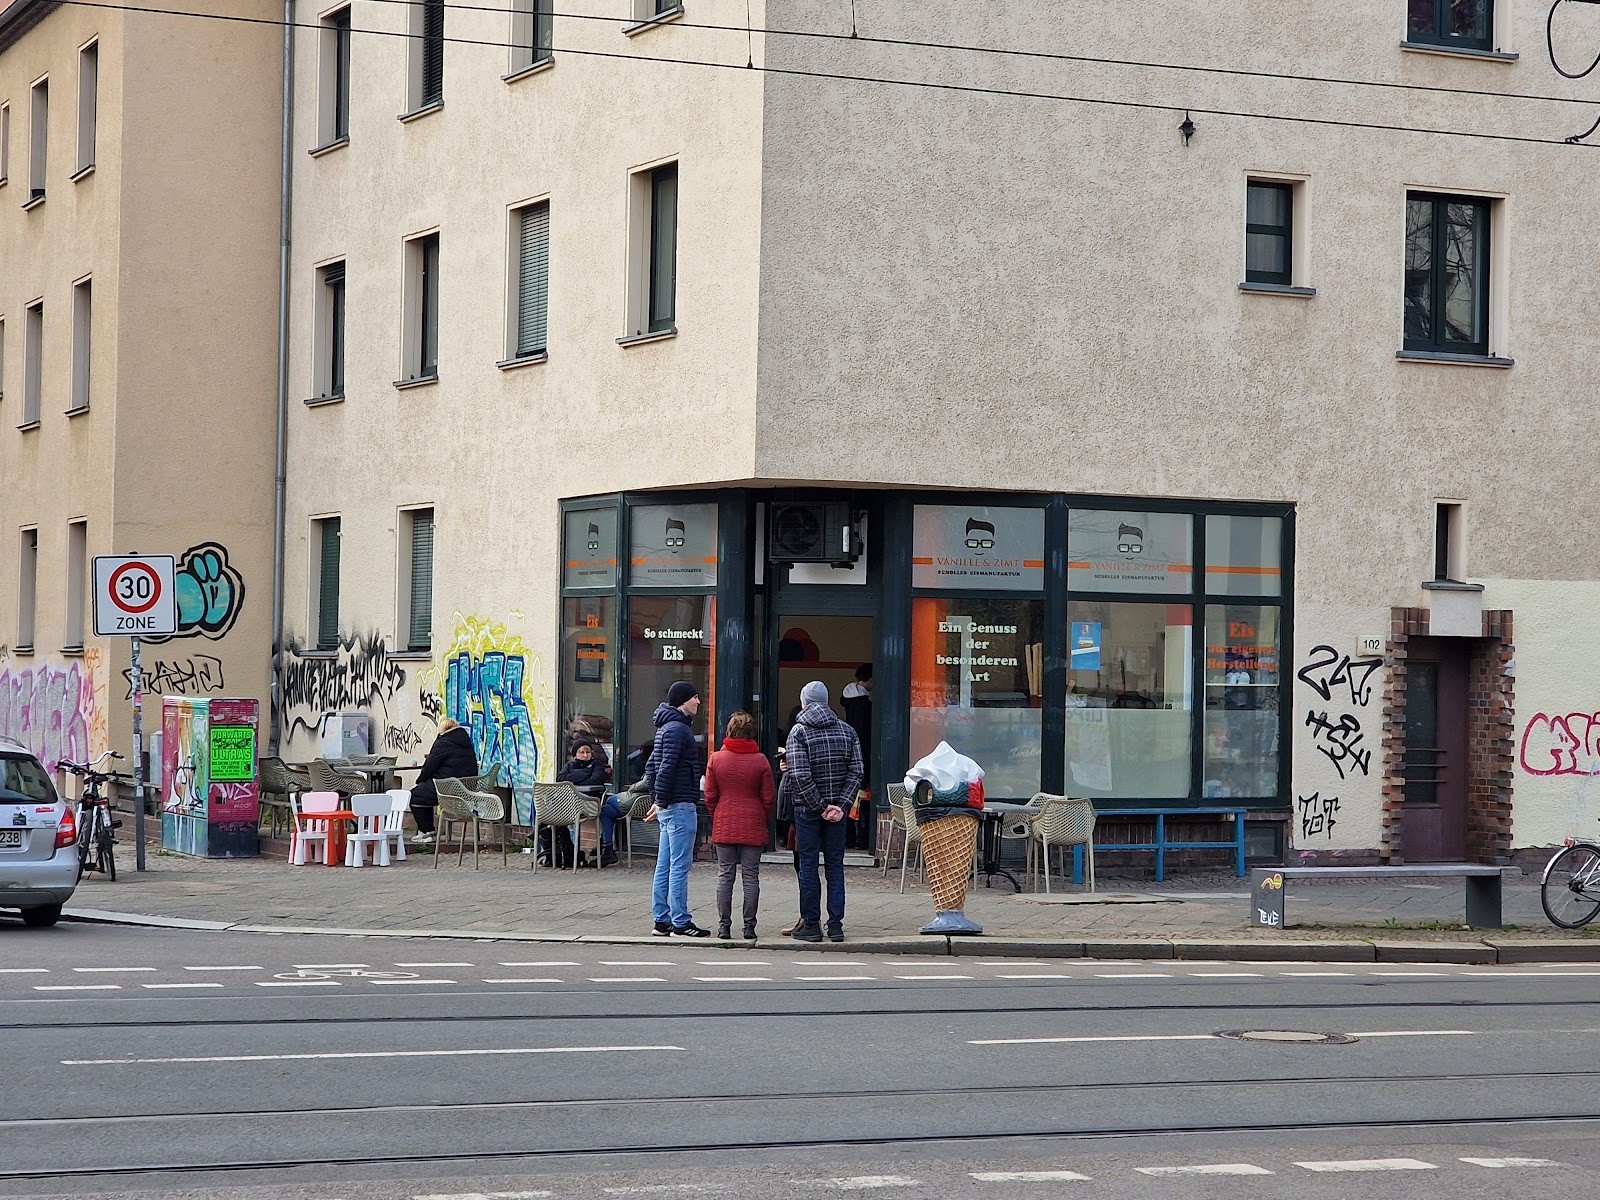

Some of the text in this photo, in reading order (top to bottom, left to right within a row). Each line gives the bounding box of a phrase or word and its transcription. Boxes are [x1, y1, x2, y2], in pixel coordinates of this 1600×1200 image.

[937, 557, 1020, 567] VANILLE & ZIMT
[1094, 561, 1130, 571] VANILLE
[120, 576, 150, 599] 30
[116, 616, 156, 629] ZONE
[938, 621, 1017, 634] Ein Genuss
[643, 627, 704, 639] So schmeckt
[1228, 621, 1256, 637] Eis
[965, 638, 990, 649] der
[1363, 639, 1380, 649] 102
[662, 645, 684, 660] Eis
[936, 654, 1018, 666] besonderen
[964, 671, 990, 682] Art
[212, 749, 251, 760] ULTRAS
